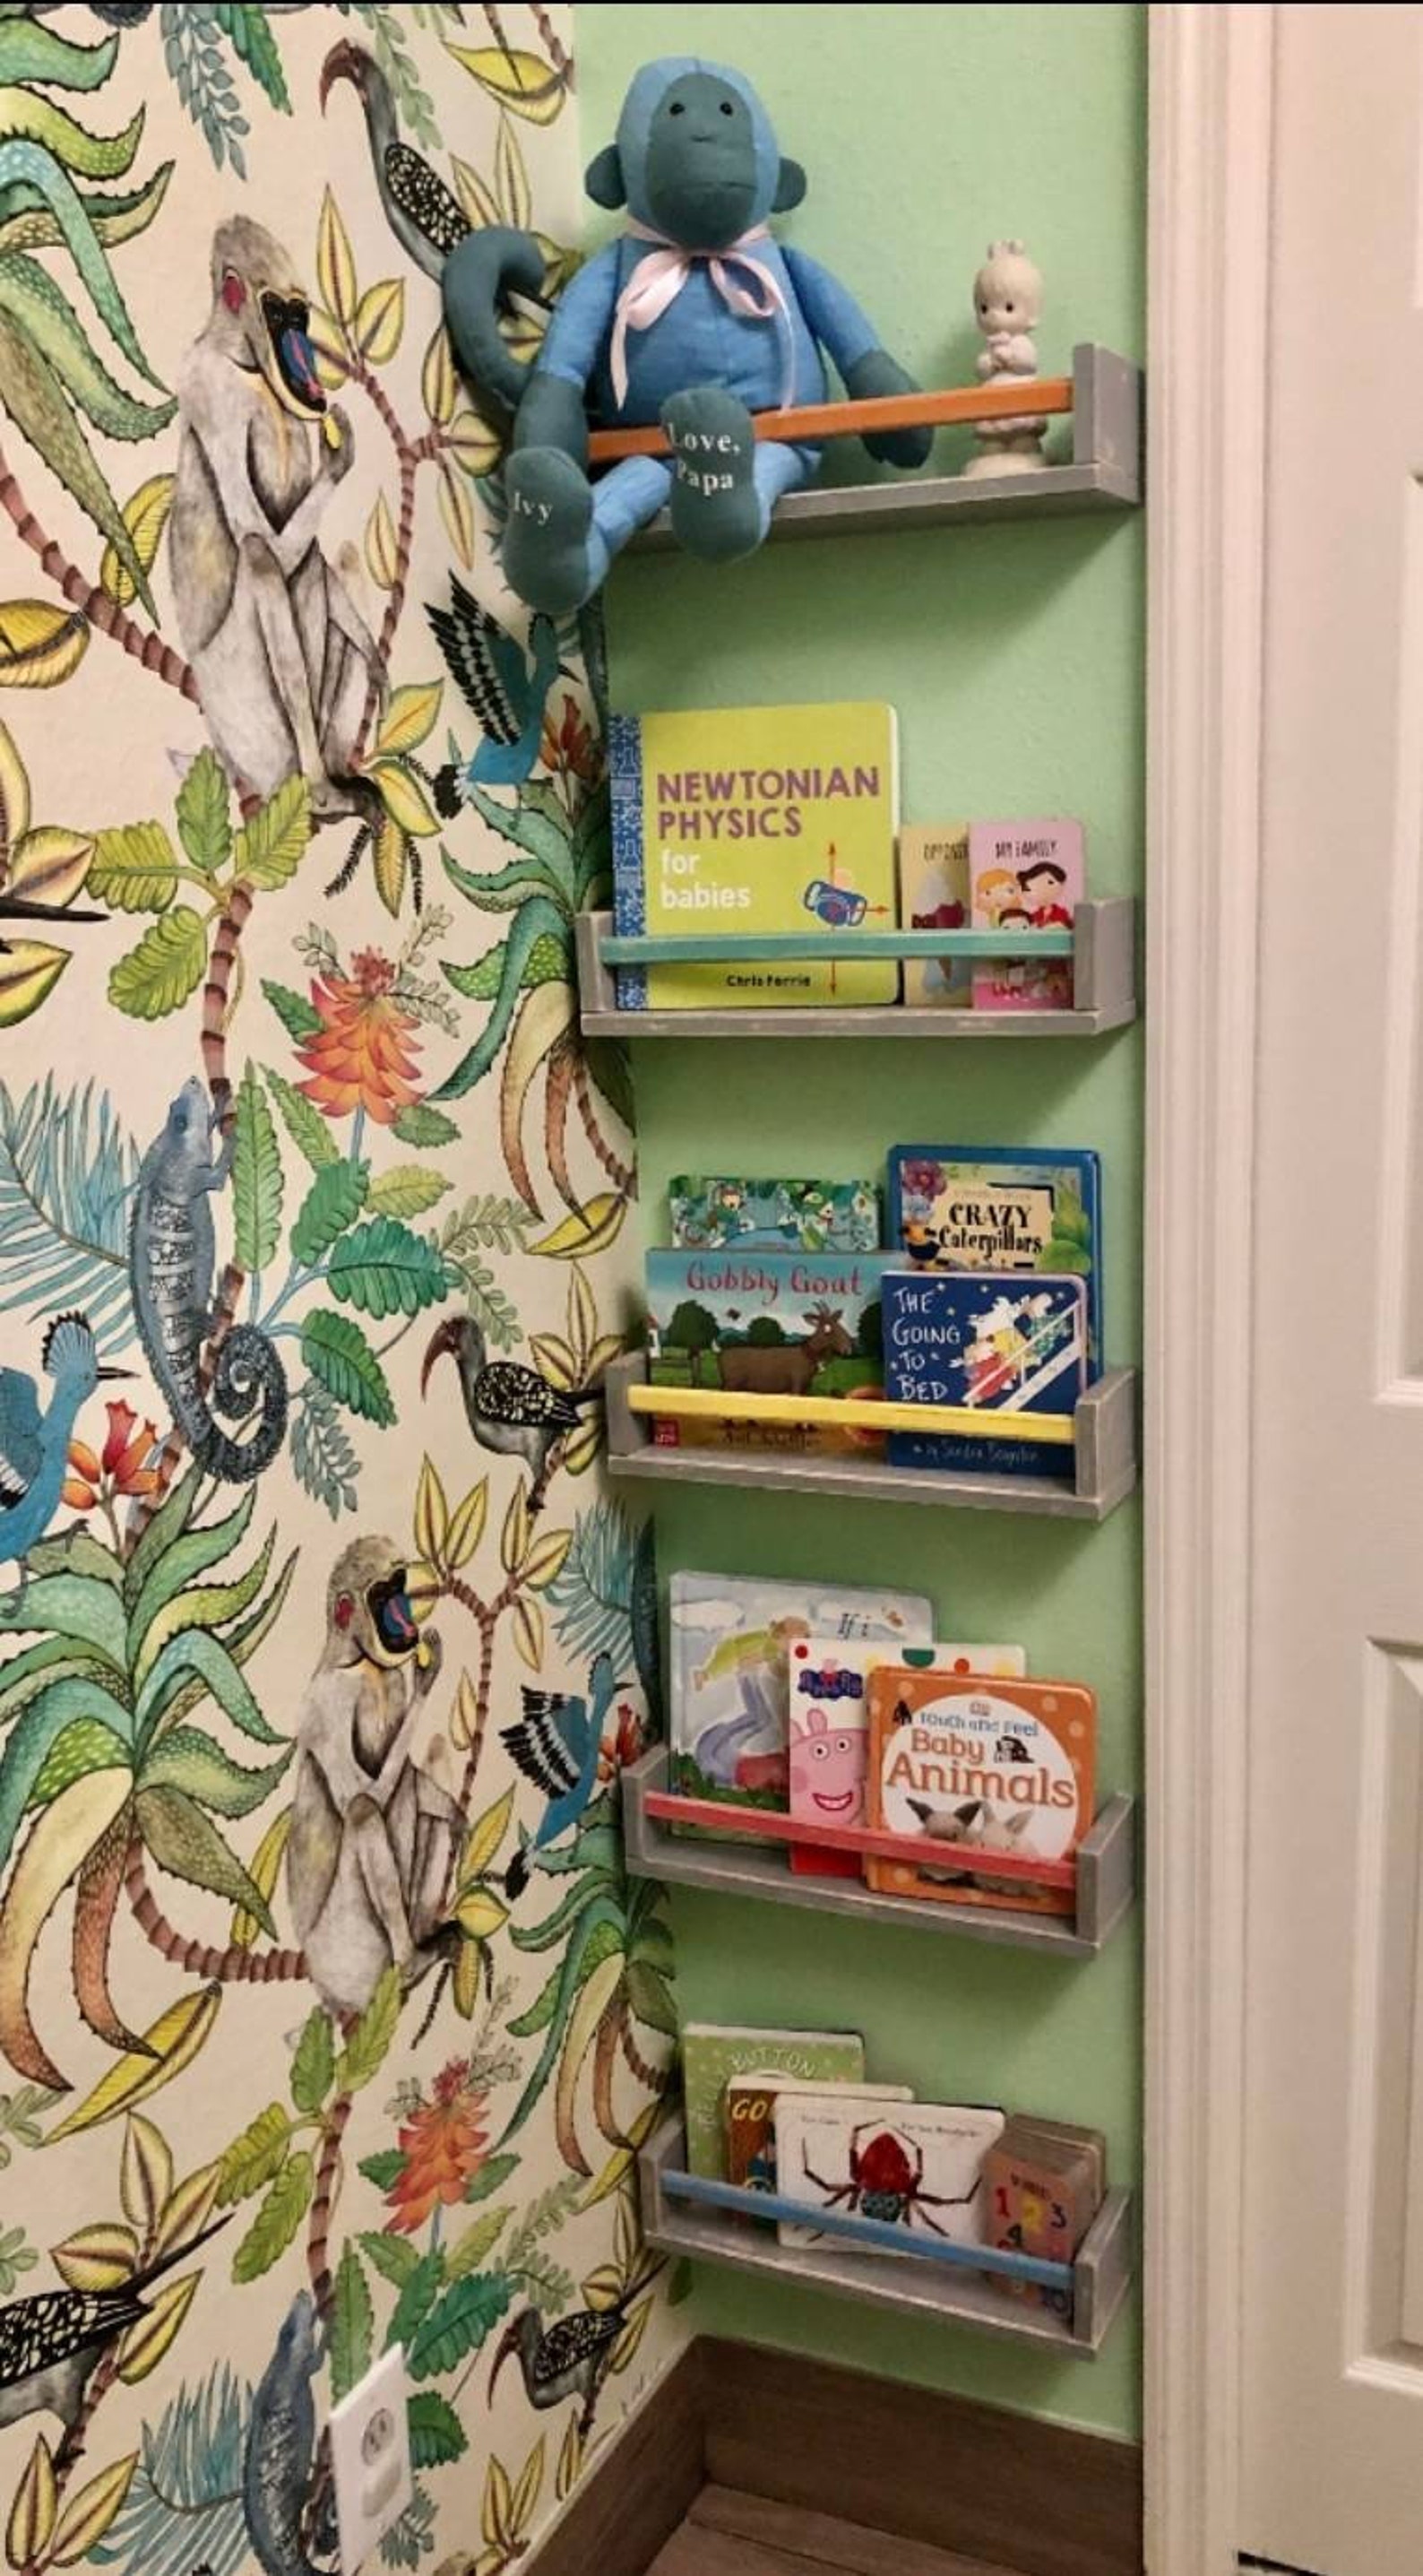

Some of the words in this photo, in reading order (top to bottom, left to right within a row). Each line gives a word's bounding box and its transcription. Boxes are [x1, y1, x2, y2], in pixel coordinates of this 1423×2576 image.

[668, 423, 741, 455] Love,
[677, 460, 734, 496] Papa
[513, 492, 553, 524] Ivy
[657, 766, 881, 803] NEWTONIAN
[659, 806, 802, 840] PHYSICS
[661, 849, 701, 874] for
[1015, 840, 1058, 858] FAMILY
[660, 882, 752, 910] babies
[726, 973, 763, 987] Chris
[948, 1202, 1031, 1228] CRAZY
[938, 1225, 1043, 1261] Caterpillars
[687, 1259, 779, 1306] Gobbly
[791, 1265, 863, 1296] Goat
[893, 1285, 934, 1314] THE
[892, 1316, 961, 1346] GOING
[896, 1373, 948, 1401] BED
[910, 1727, 985, 1766] Baby
[885, 1750, 1076, 1809] Animals
[730, 2046, 817, 2080] BUTTON
[731, 2098, 768, 2122] GO
